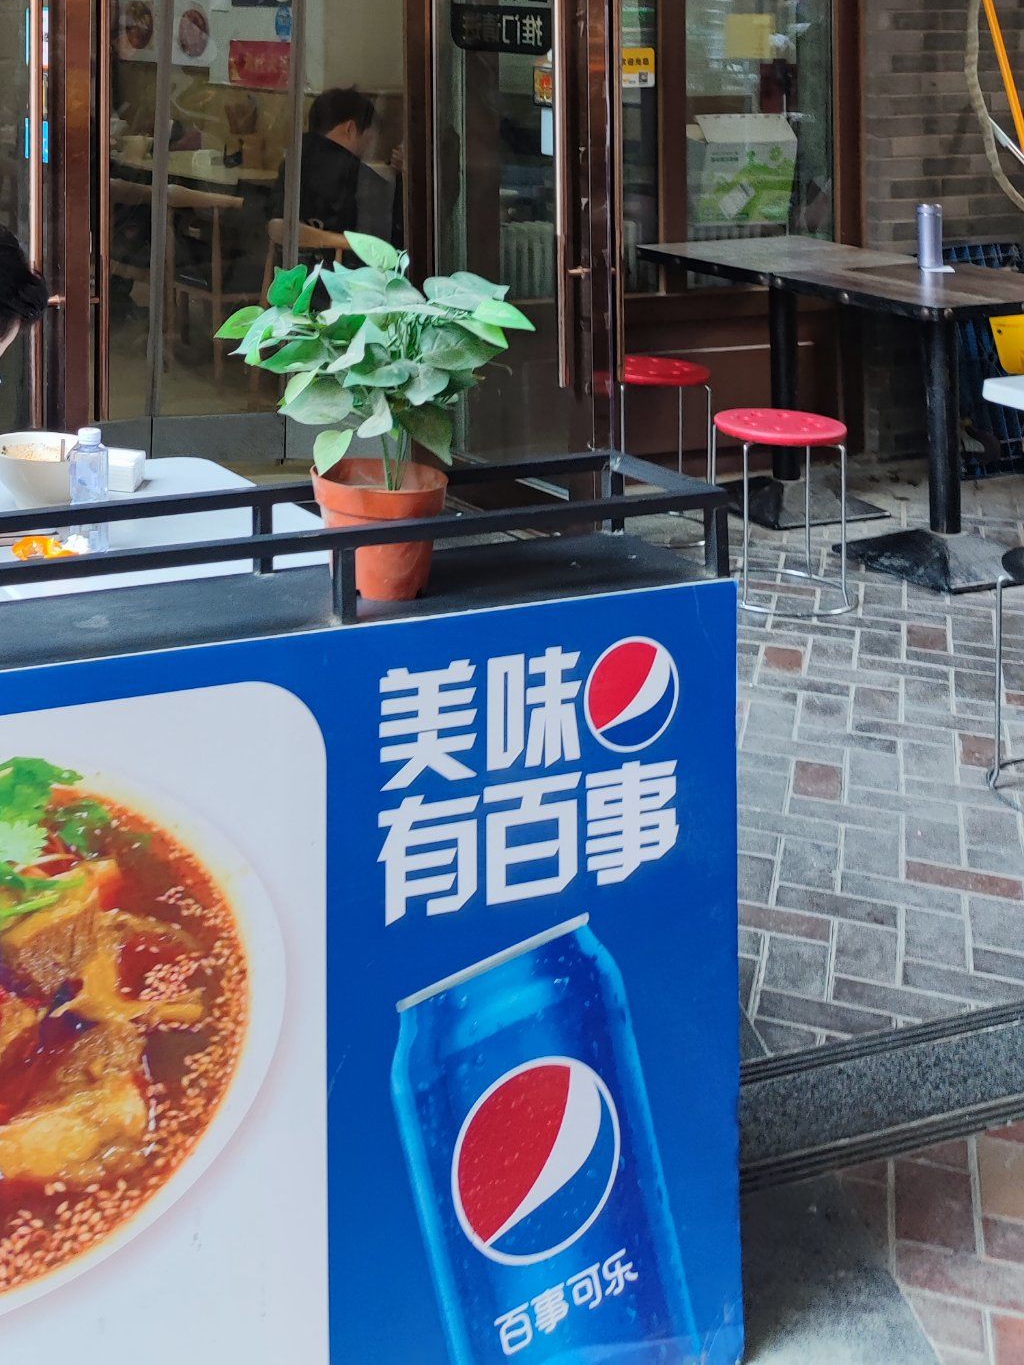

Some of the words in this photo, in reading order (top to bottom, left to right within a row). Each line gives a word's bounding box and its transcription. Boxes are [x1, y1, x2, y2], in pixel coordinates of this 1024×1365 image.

[378, 645, 582, 793] 美味
[376, 759, 680, 927] 有百事
[493, 1247, 639, 1356] 百事可乐
